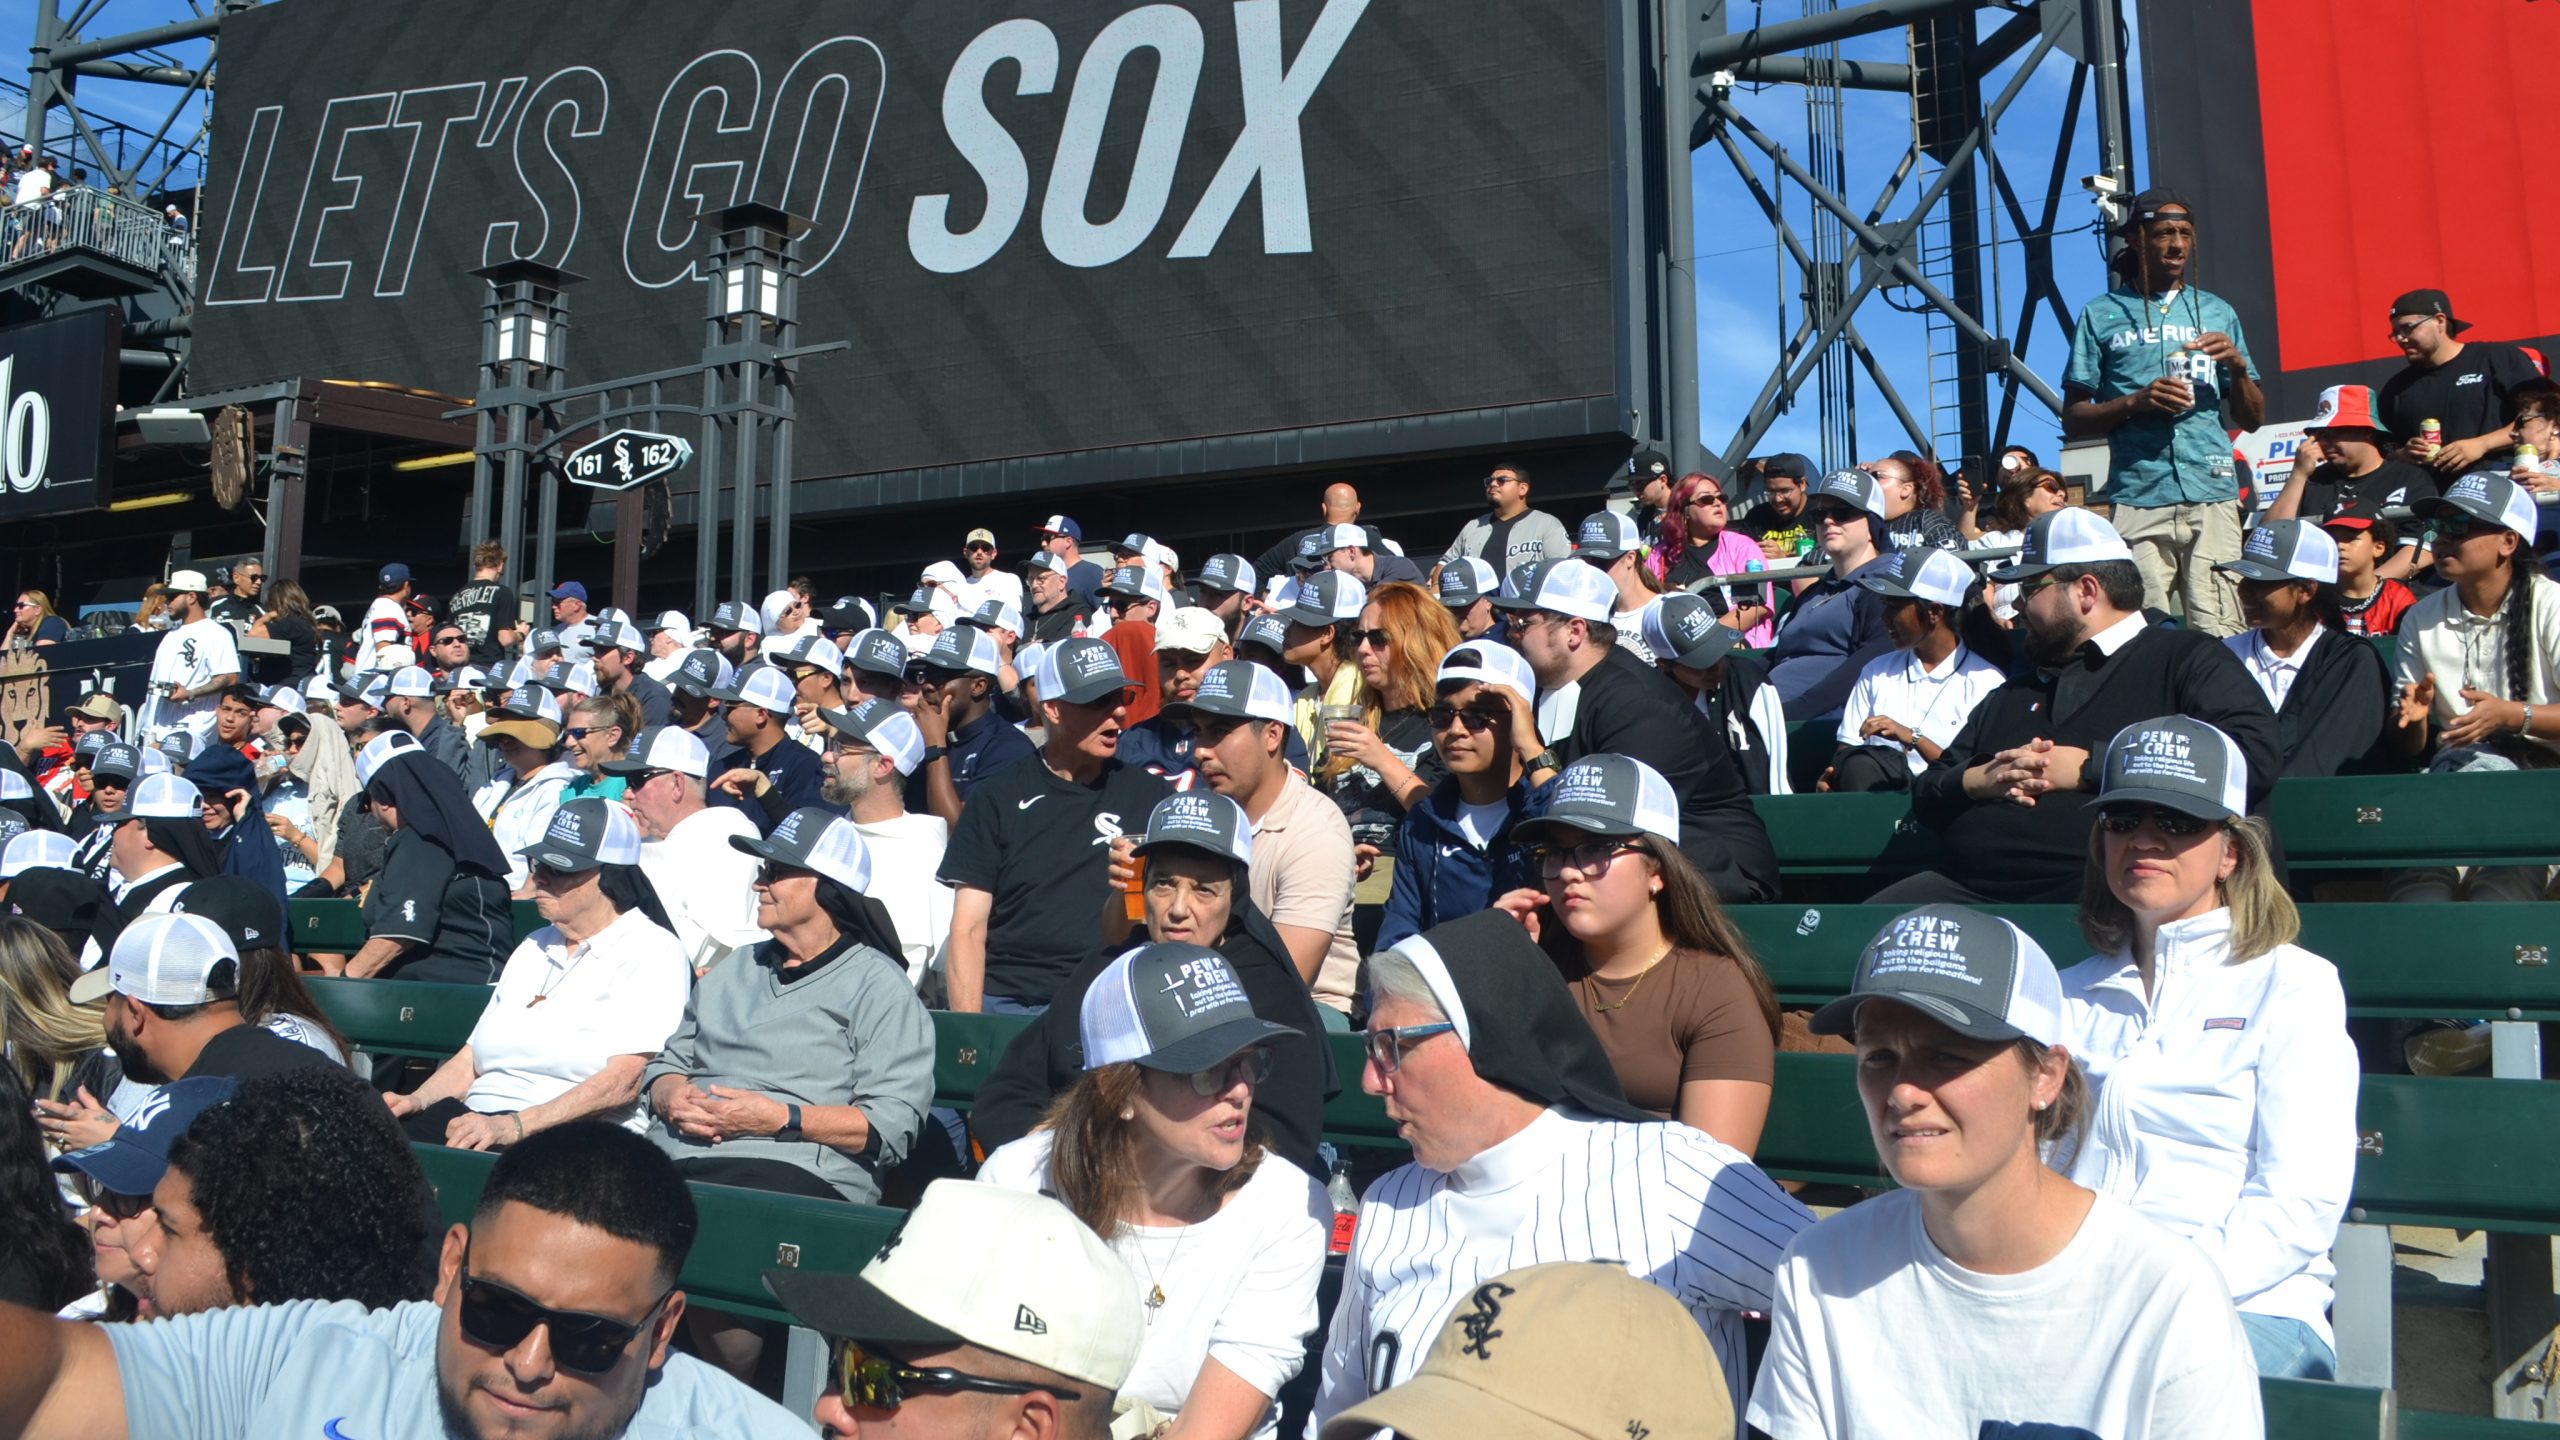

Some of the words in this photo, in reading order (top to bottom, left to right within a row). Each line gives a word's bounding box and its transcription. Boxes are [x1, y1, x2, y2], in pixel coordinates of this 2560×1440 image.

[205, 66, 609, 306] LET'S
[622, 35, 887, 289] GO
[907, 0, 1372, 274] SOX
[2456, 373, 2484, 386] Ford
[575, 453, 602, 476] 161
[641, 443, 671, 467] 162
[1087, 651, 1109, 663] CREW
[1203, 675, 1227, 685] CREW
[2139, 731, 2172, 743] PEW
[2144, 742, 2190, 759] CREW
[2152, 756, 2182, 766] religious
[1566, 764, 1589, 777] PEW
[2164, 762, 2196, 775] ballgame
[1566, 775, 1603, 787] CREW
[1172, 796, 1197, 807] PEW
[1175, 805, 1209, 817] CREW
[2360, 811, 2377, 820] 23
[557, 817, 580, 830] CREW
[1893, 915, 1937, 934] PEW
[1896, 932, 1960, 951] CREW
[1882, 948, 1908, 959] taking
[1909, 949, 1947, 962] religious
[1949, 951, 1966, 963] life
[2520, 950, 2542, 961] 23
[1180, 957, 1214, 979] PEW
[1881, 958, 1895, 966] out
[1894, 957, 1906, 965] to
[1906, 957, 1922, 966] the
[1922, 957, 1967, 972] ballgame
[1193, 968, 1231, 988] CREW
[1890, 964, 1907, 974] with
[1907, 966, 1919, 974] us
[1919, 966, 1934, 975] for
[1934, 968, 1983, 986] vocations!
[1189, 987, 1213, 999] taking
[1194, 998, 1206, 1007] out
[1206, 996, 1214, 1004] to
[1189, 1005, 1206, 1018] pray
[962, 1052, 973, 1061] 17
[781, 1250, 794, 1261] 18
